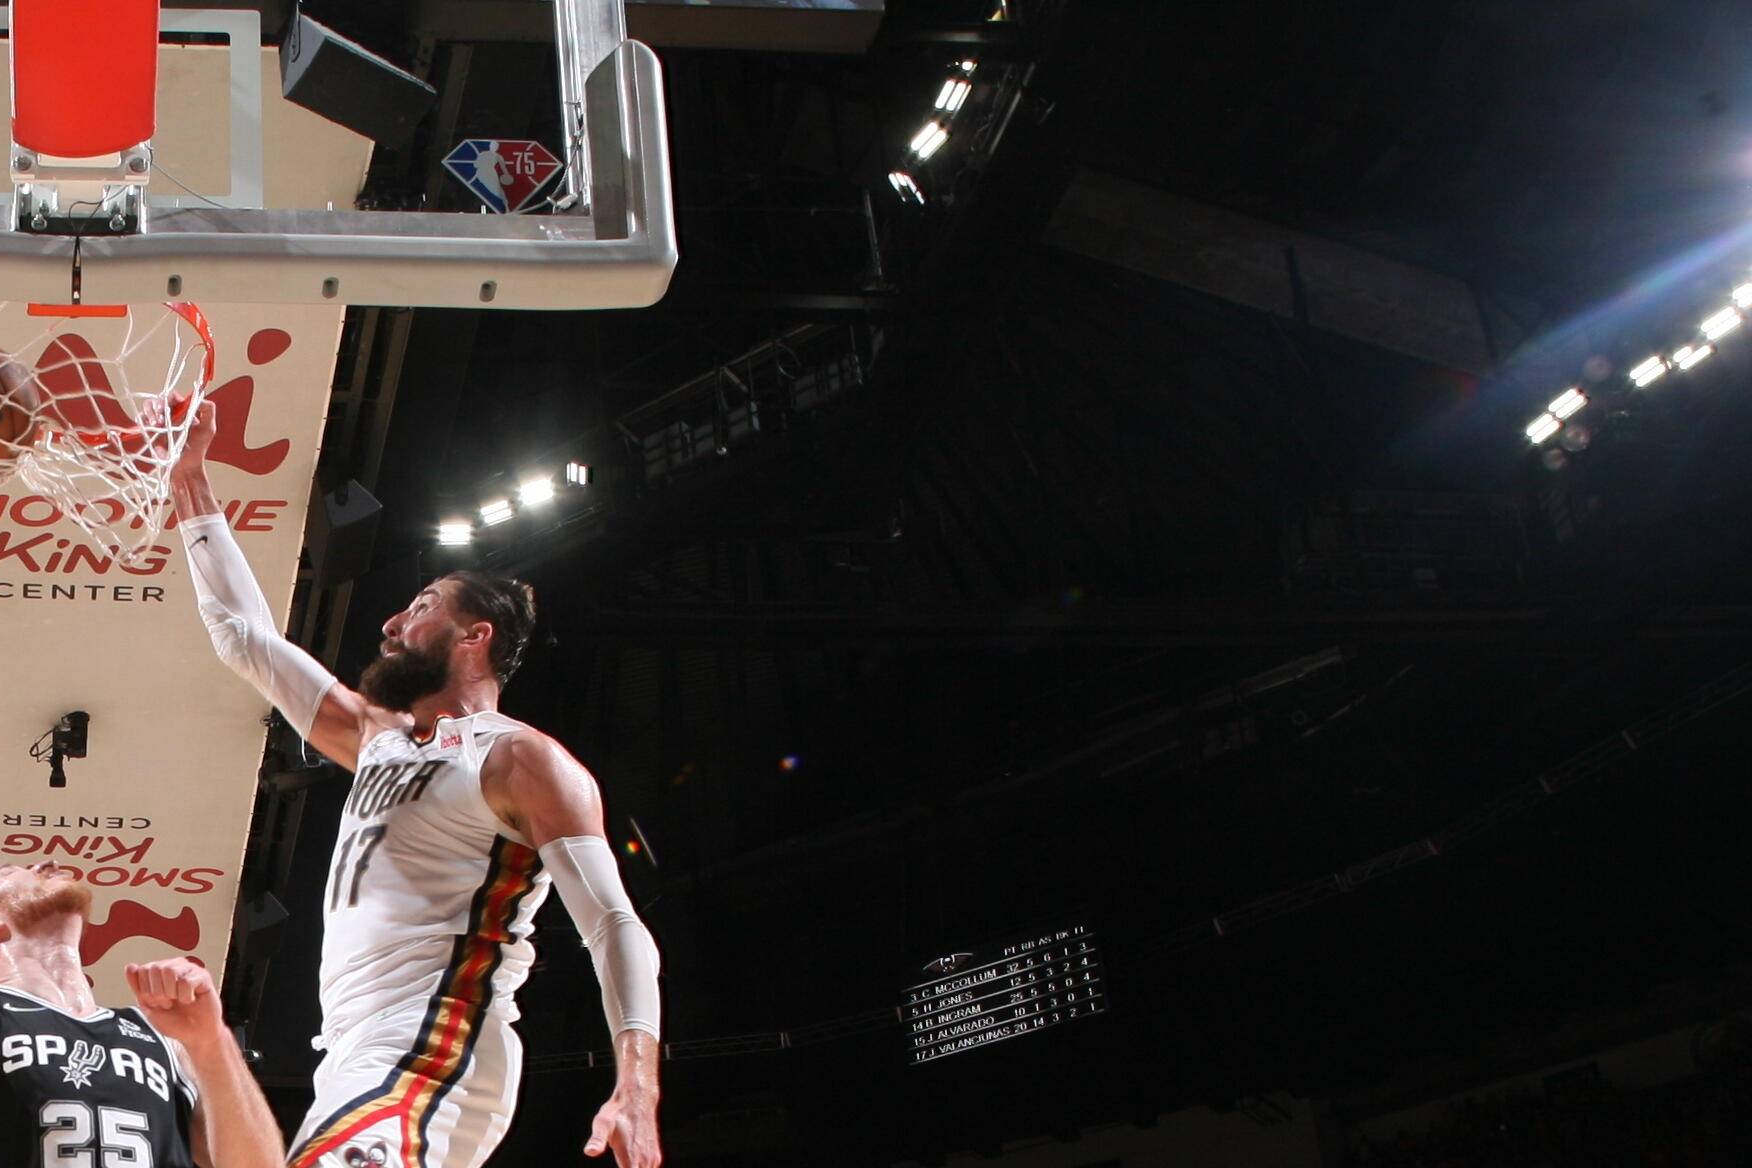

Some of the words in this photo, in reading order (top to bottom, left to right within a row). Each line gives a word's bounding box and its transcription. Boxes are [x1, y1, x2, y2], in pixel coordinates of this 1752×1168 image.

[512, 152, 535, 175] 75
[3, 814, 152, 829] CENTER
[330, 823, 388, 913] 17
[938, 1004, 981, 1024] INGRAM
